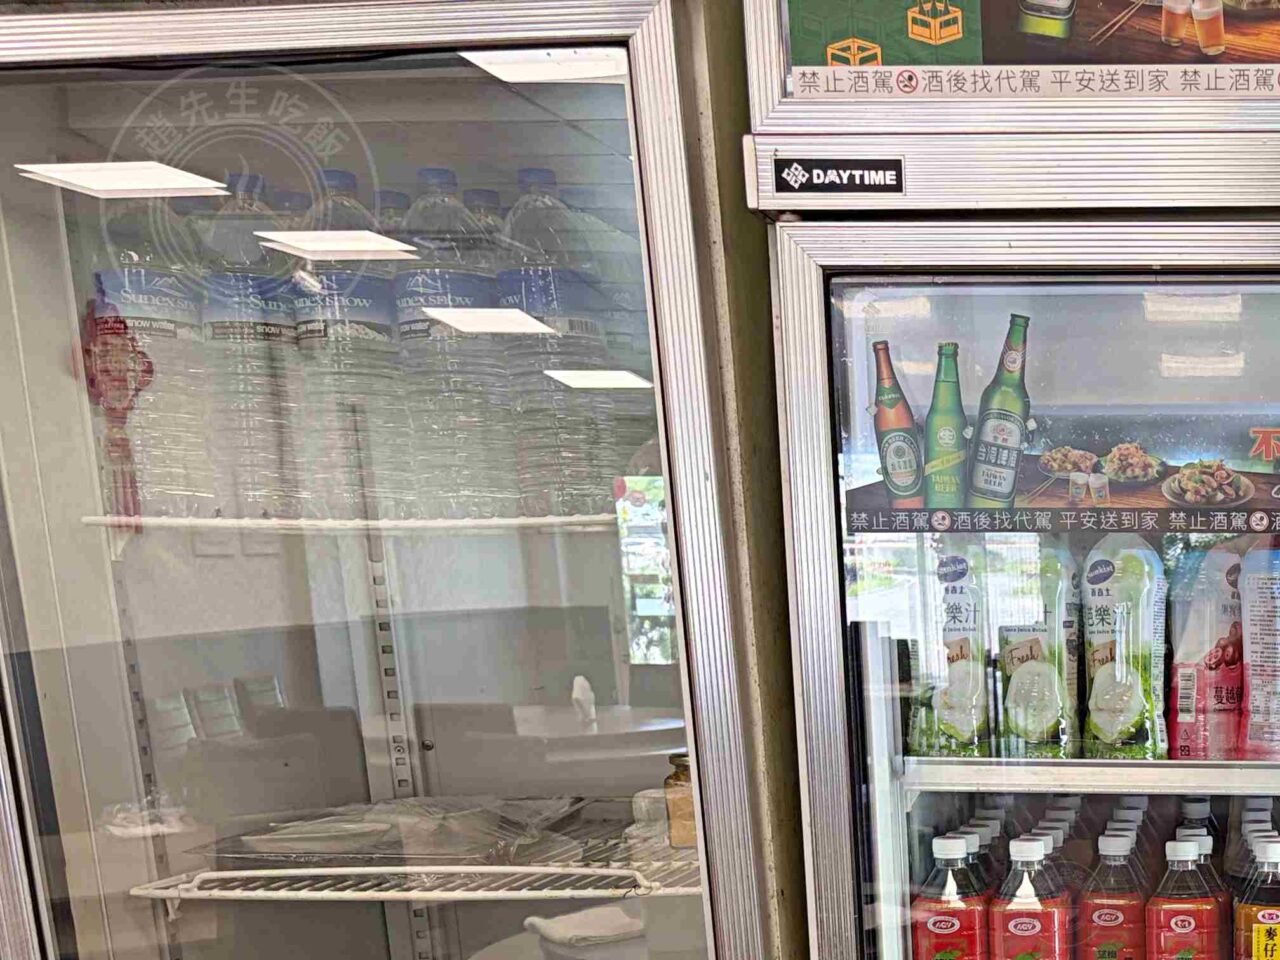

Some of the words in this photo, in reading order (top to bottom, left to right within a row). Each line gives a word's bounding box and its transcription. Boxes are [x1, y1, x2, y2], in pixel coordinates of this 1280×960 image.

[798, 70, 893, 95] 禁止酒駕
[921, 69, 1041, 94] 酒後找代駕
[1050, 68, 1170, 94] 平安送到家
[1180, 67, 1275, 92] 禁止酒駕
[812, 169, 897, 186] DAYTIME
[151, 319, 175, 331] water
[850, 511, 930, 530] 禁止酒駕
[953, 511, 1052, 530] 酒後找代駕
[1059, 511, 1159, 530] 平安送到家
[1169, 512, 1248, 531] 禁止酒駕
[945, 602, 980, 625] 樂汁
[1005, 645, 1040, 666] Fresh
